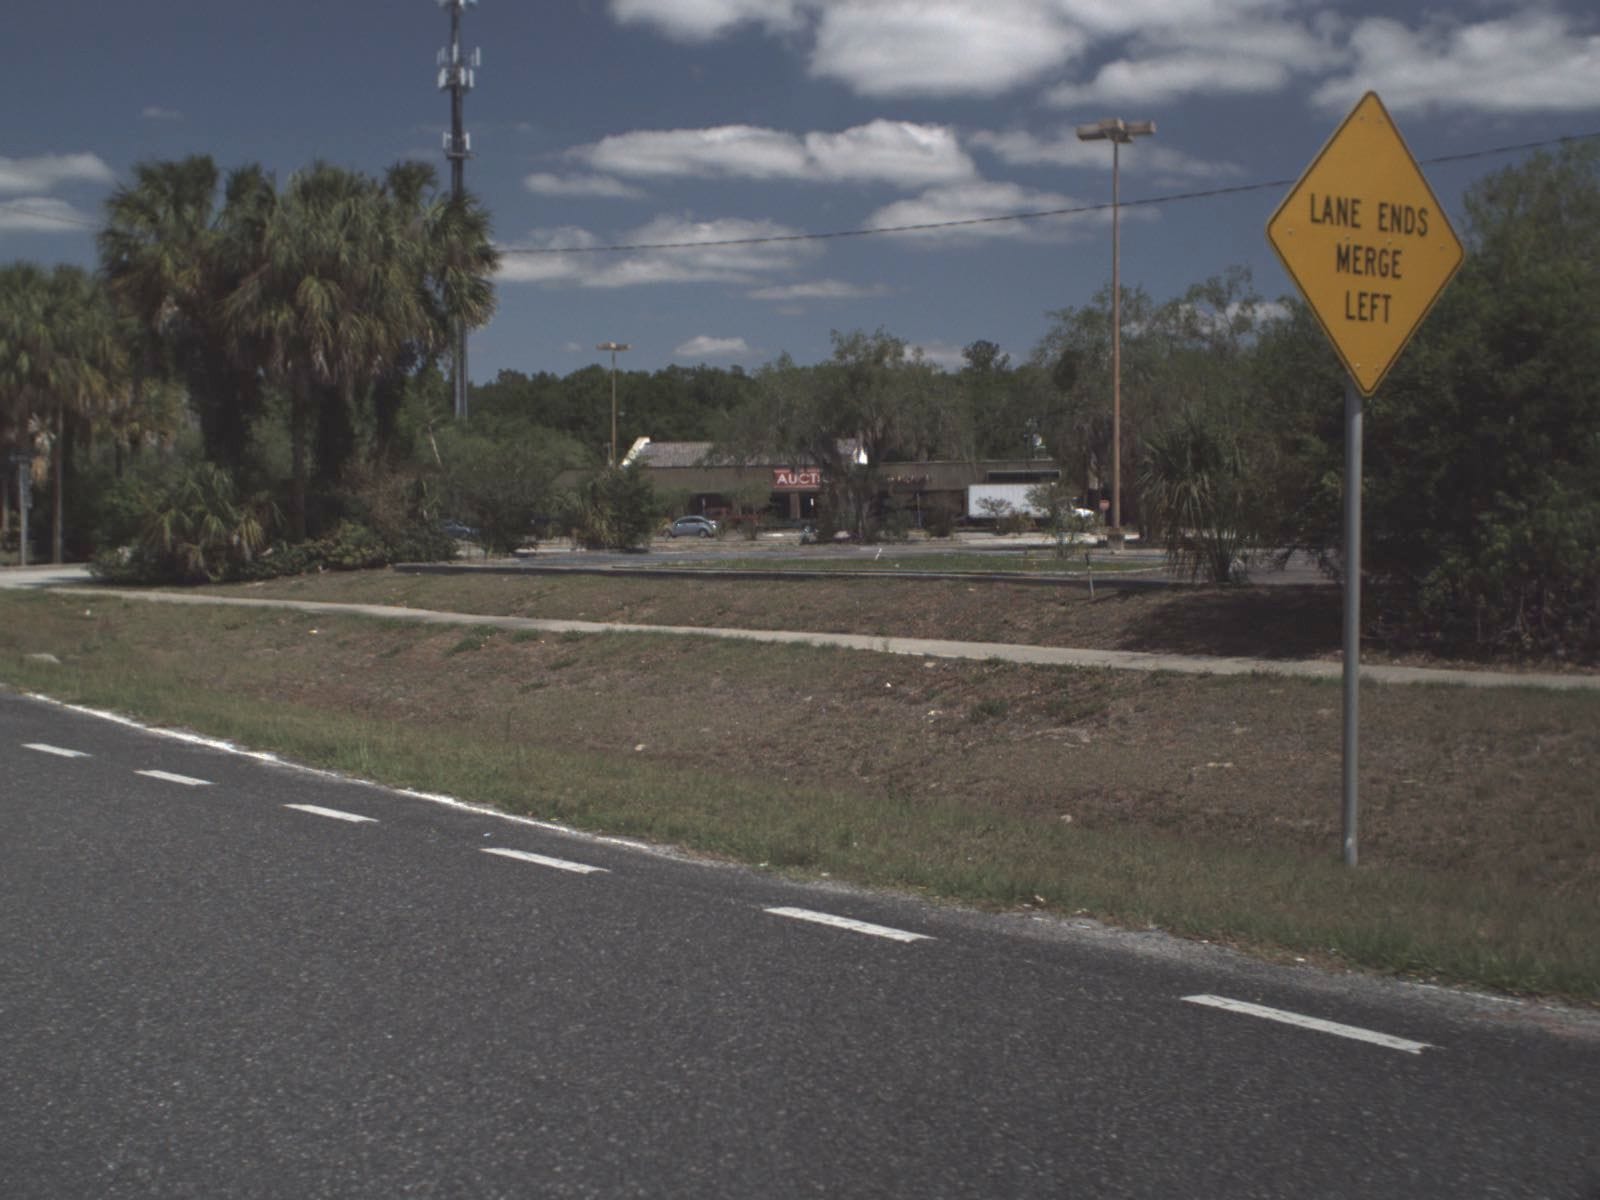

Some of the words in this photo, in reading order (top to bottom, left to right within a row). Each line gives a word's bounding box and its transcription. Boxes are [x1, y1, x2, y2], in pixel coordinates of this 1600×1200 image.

[1310, 192, 1361, 228] LANE
[1378, 202, 1428, 237] ENDS
[1336, 243, 1402, 279] MERGE
[1345, 290, 1391, 323] LEFT
